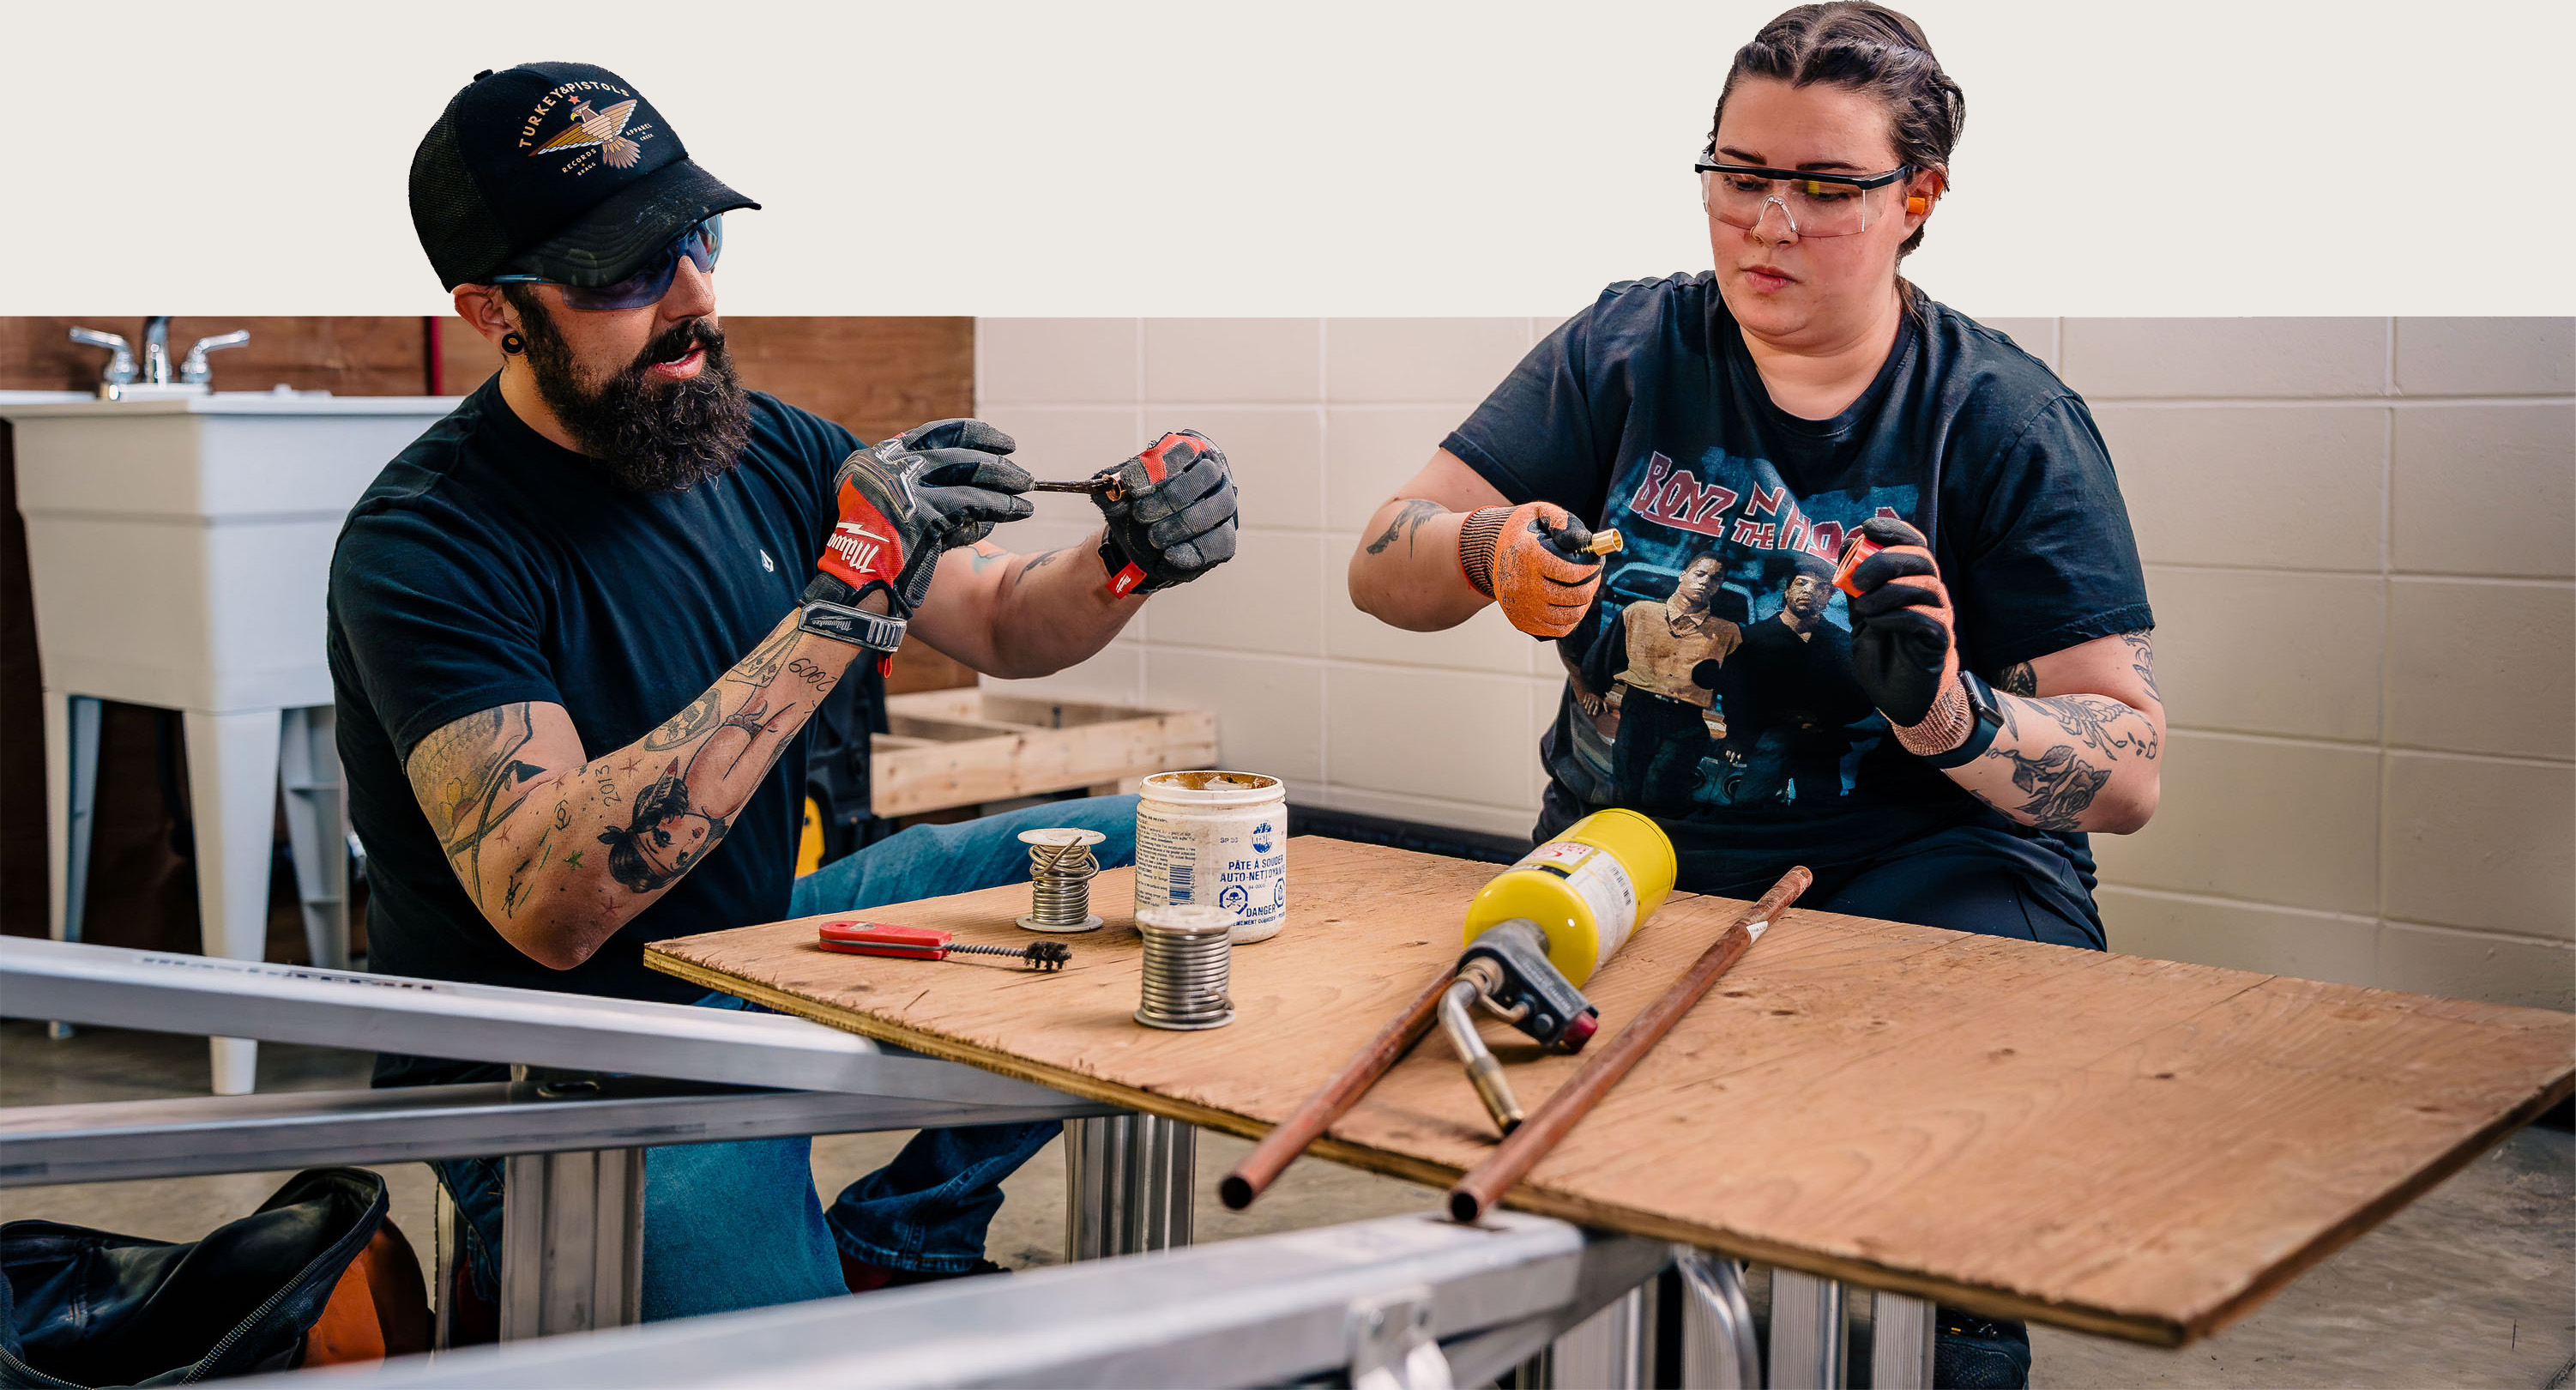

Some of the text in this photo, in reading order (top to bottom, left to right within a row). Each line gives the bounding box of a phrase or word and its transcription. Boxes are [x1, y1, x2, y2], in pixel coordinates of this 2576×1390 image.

[625, 123, 653, 136] APPAREL
[562, 148, 596, 172] RECORDS
[577, 162, 596, 176] BRAGG
[1629, 450, 1738, 537] BOYZ
[1745, 480, 1785, 516] N
[1731, 518, 1776, 549] THE
[788, 658, 838, 692] 2009
[594, 764, 622, 807] 2013
[1228, 859, 1252, 870] PÂTE
[1262, 855, 1283, 868] SOUDER
[1246, 904, 1276, 917] DANGER
